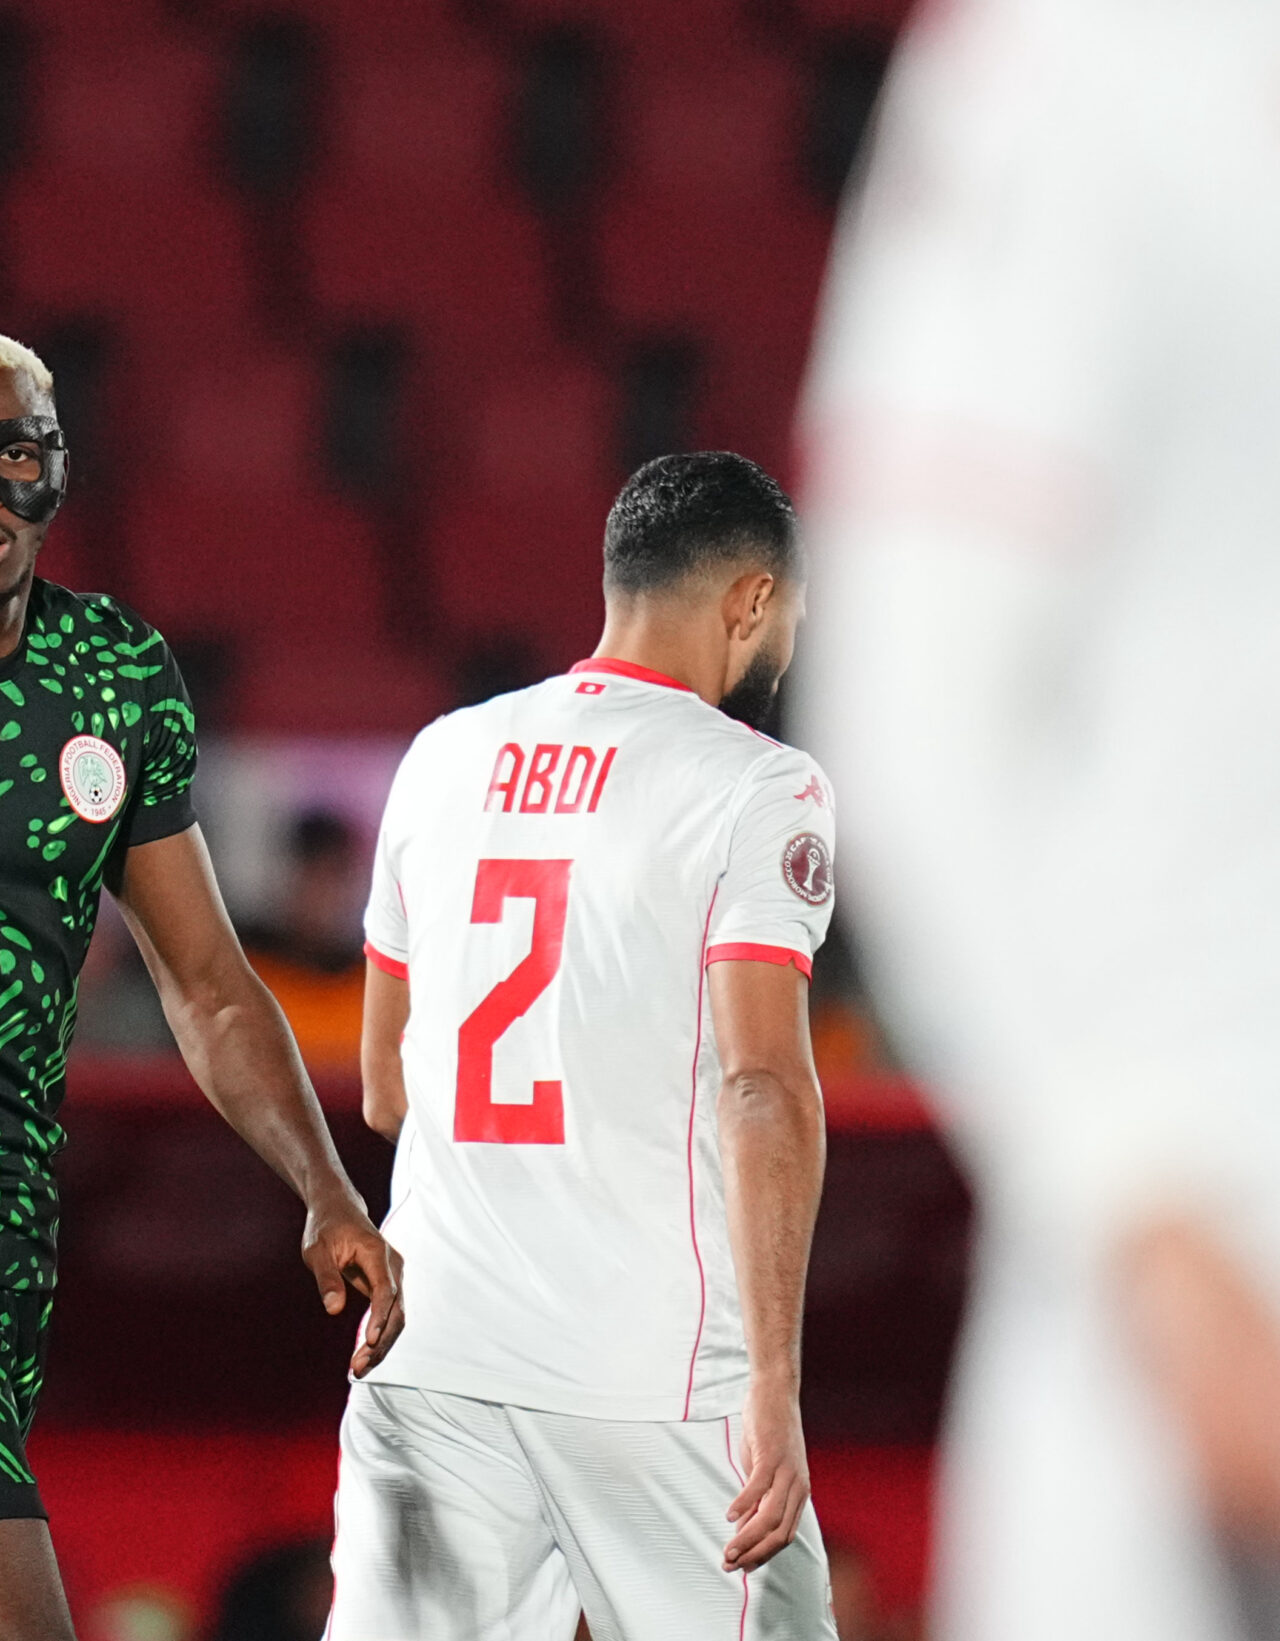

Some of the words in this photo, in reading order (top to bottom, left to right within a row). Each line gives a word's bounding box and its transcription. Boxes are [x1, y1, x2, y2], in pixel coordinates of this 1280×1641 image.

[64, 739, 97, 765] FOOTBALL
[63, 766, 81, 806] NIGERIA
[99, 745, 122, 804] FEDERATION
[483, 742, 618, 814] ABDI
[91, 808, 106, 817] 1945
[790, 837, 807, 852] CAF
[784, 861, 807, 898] MOROCCO
[453, 858, 575, 1145] 2
